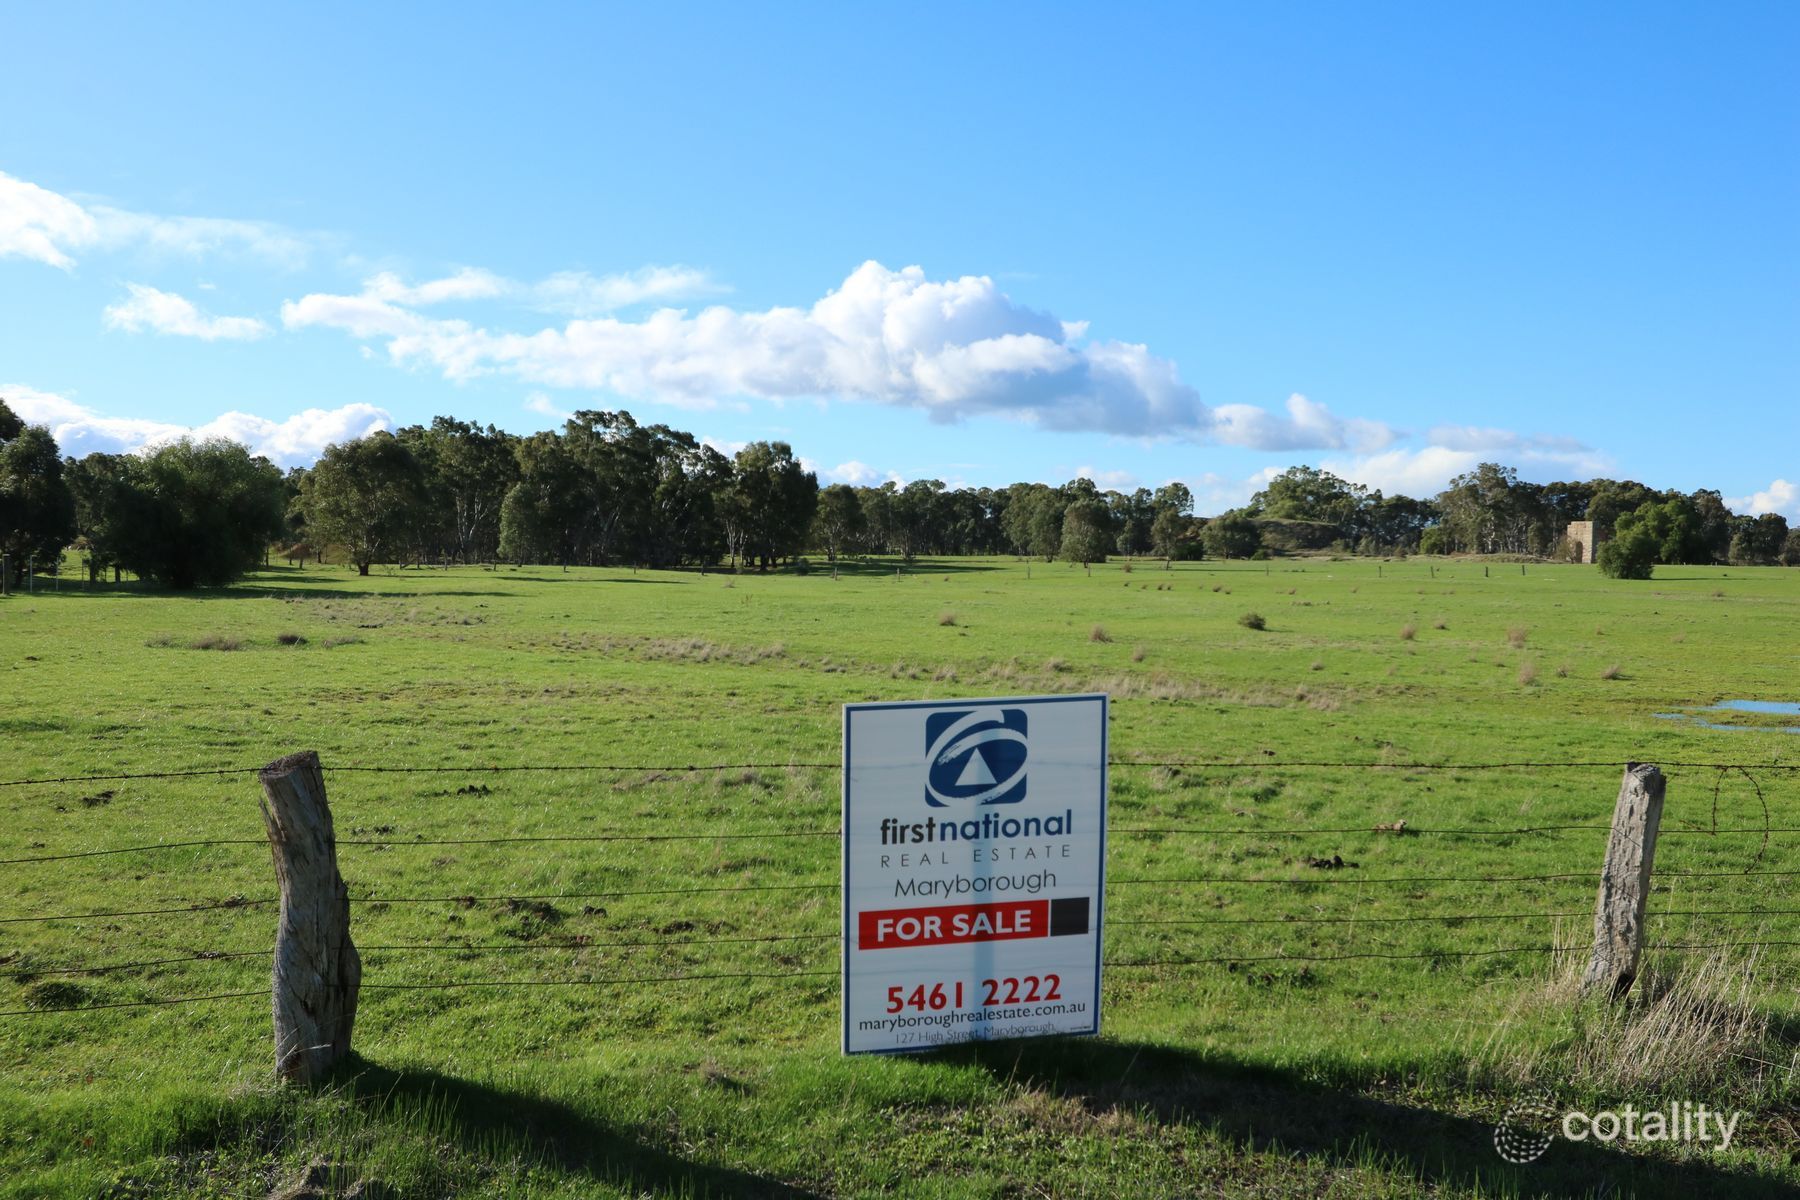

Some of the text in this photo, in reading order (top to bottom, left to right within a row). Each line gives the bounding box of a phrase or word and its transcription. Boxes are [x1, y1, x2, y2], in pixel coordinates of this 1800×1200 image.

[881, 845, 1071, 868] REAL ESTATE
[894, 869, 1057, 899] Maryborough
[877, 910, 1032, 942] FOR SALE
[886, 974, 1061, 1013] 5461 2222
[859, 1001, 1086, 1032] maryboroughrealestate.com.au
[895, 1032, 915, 1044] 127
[918, 1030, 944, 1044] High
